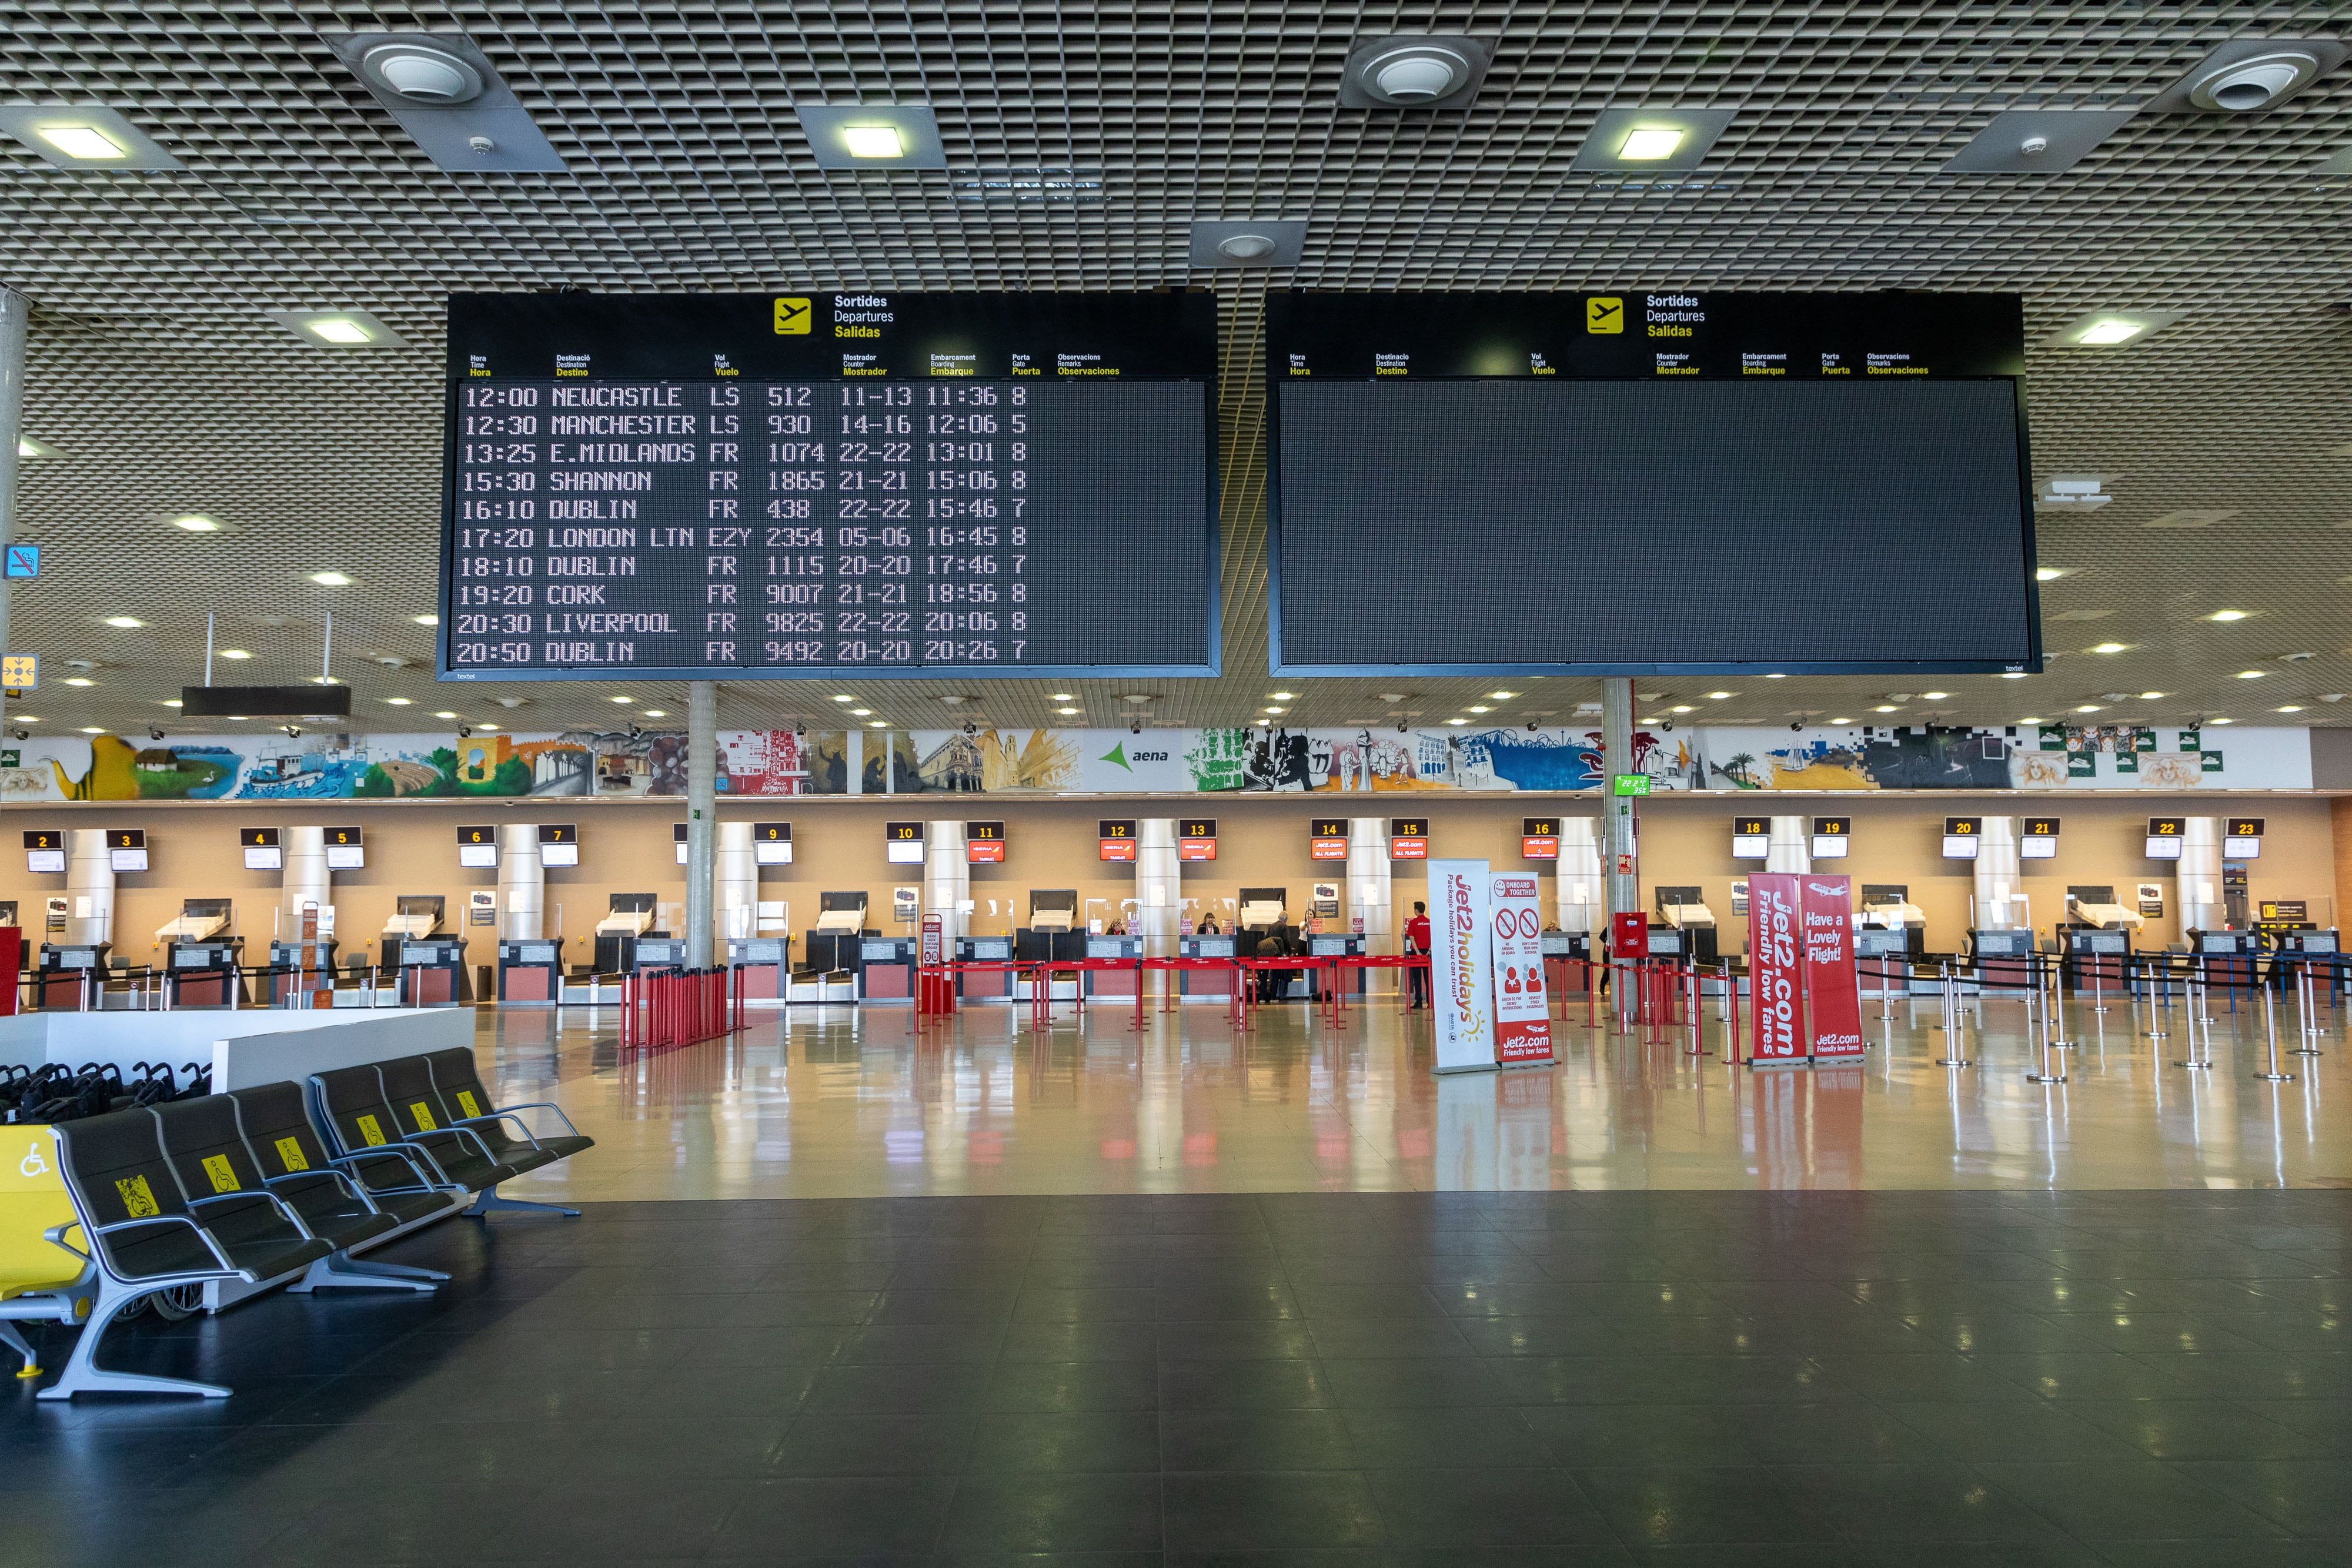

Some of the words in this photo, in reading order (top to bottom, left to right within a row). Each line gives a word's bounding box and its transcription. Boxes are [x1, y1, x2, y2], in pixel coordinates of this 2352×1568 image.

[835, 296, 887, 307] Sortides
[1646, 295, 1698, 307] Sortides
[834, 310, 894, 324] Departures
[1646, 310, 1705, 324] Departures
[835, 326, 880, 338] Salidas
[1648, 325, 1692, 337] Salidas
[556, 368, 589, 376] Destino
[715, 368, 739, 376] Vuelo
[843, 367, 887, 376] Mostrador
[931, 367, 974, 377] Embarque
[467, 389, 537, 406] 12:00
[553, 388, 681, 406] NEWCASTLE
[711, 387, 739, 405] LS
[769, 387, 810, 406] 512
[843, 387, 911, 405] 11-13
[928, 387, 997, 405] 11:36
[1013, 387, 1025, 404] 8
[467, 416, 536, 434] 12:30
[552, 416, 695, 434] MANCHESTER
[711, 416, 738, 433] LS
[769, 416, 810, 433] 930
[843, 415, 911, 433] 14-16
[928, 415, 997, 433] 12:06
[1013, 415, 1025, 433] 5
[466, 444, 536, 463] 13:25
[551, 444, 694, 462] E.MIDLANDS
[710, 443, 738, 462] FR
[770, 443, 824, 462] 1074
[840, 443, 910, 461] 22-22
[928, 443, 993, 461] 13:01
[1013, 443, 1025, 460] 8
[465, 473, 534, 491] 15:30
[551, 472, 650, 490] SHANNON
[710, 472, 737, 490] FR
[770, 472, 824, 490] 1865
[840, 472, 907, 490] 21-21
[928, 471, 997, 489] 15:06
[1013, 471, 1025, 489] 8
[464, 501, 534, 519] 16:10
[550, 500, 636, 519] DUBLIN
[710, 500, 737, 518] FR
[768, 500, 809, 518] 438
[840, 500, 910, 517] 22-22
[928, 499, 997, 517] 15:46
[1013, 499, 1025, 517] 7
[463, 529, 533, 547] 17:20
[549, 529, 635, 547] LONDON
[651, 529, 693, 546] LTN
[709, 528, 751, 546] EZY
[767, 528, 823, 546] 2354
[840, 528, 910, 546] 05-06
[928, 527, 997, 546] 16:45
[1013, 527, 1025, 545] 8
[462, 557, 532, 576] 18:10
[549, 557, 634, 575] DUBLIN
[709, 557, 736, 574] FR
[769, 556, 823, 574] 1115
[839, 556, 910, 574] 20-20
[928, 556, 997, 574] 17:46
[1013, 556, 1025, 573] 7
[462, 586, 532, 604] 19:20
[547, 586, 604, 604] CORK
[709, 585, 736, 603] FR
[767, 585, 823, 603] 9007
[839, 584, 906, 603] 21-21
[928, 584, 997, 602] 18:56
[1013, 584, 1025, 601] 8
[459, 615, 531, 633] 20:30
[547, 614, 677, 633] LIVERPOOL
[708, 613, 735, 631] FR
[766, 613, 823, 631] 9825
[839, 613, 910, 631] 22-22
[926, 612, 997, 631] 20:06
[1013, 612, 1025, 630] 8
[457, 643, 530, 662] 20:50
[546, 643, 633, 661] DUBLIN
[707, 642, 735, 660] FR
[766, 642, 823, 660] 9492
[838, 641, 910, 660] 20-20
[926, 641, 997, 659] 20:26
[1013, 640, 1025, 658] 7
[1132, 752, 1168, 761] aena
[899, 828, 913, 838] 10
[980, 827, 993, 838] 11
[1111, 826, 1125, 837] 12
[1191, 825, 1205, 835] 13
[1323, 824, 1337, 835] 14
[1404, 824, 1417, 835] 15
[1535, 824, 1549, 834] 16
[1746, 823, 1760, 833] 18
[1826, 823, 1840, 834] 19
[1956, 823, 1971, 834] 20
[2035, 823, 2049, 834] 21
[2160, 823, 2174, 834] 22
[2239, 824, 2254, 834] 23
[256, 834, 265, 844] 4
[338, 833, 346, 843] 5
[472, 832, 480, 842] 6
[554, 830, 562, 841] 7
[769, 829, 777, 840] 9
[39, 837, 47, 847] 2
[122, 835, 131, 847] 3
[1806, 912, 1833, 926] Have
[1836, 915, 1843, 926] a
[1759, 890, 1773, 964] Friendly
[1807, 930, 1841, 946] Lovely
[1455, 874, 1475, 1022] Jet2holidays
[1809, 947, 1841, 964] Flight!
[1773, 891, 1795, 1055] Jet2.com
[1761, 969, 1773, 1002] low
[1762, 1007, 1775, 1054] fares
[1504, 1036, 1549, 1048] Jet2.com
[1817, 1034, 1859, 1046] Jet2.com
[1504, 1048, 1525, 1058] Friendly
[1817, 1045, 1836, 1054] Friendly
